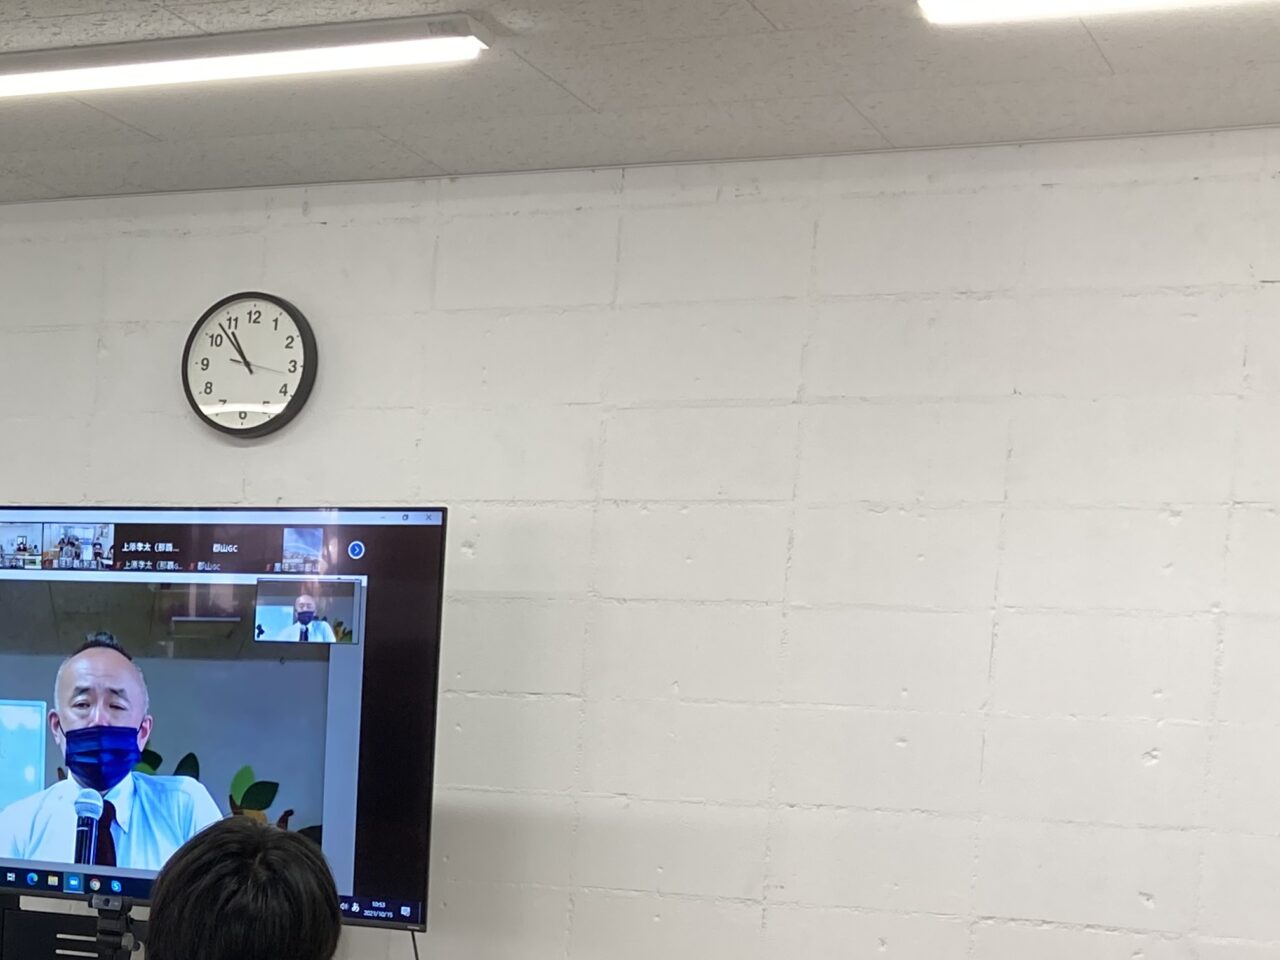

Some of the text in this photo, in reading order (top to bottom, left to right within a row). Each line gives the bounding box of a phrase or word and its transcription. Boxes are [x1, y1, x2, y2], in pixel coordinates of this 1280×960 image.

[226, 316, 239, 330] 11
[247, 310, 262, 324] 12
[272, 317, 279, 331] 1
[209, 333, 223, 347] 10
[285, 335, 295, 349] 2
[200, 357, 210, 371] 9
[288, 360, 298, 374] 3
[204, 381, 213, 395] 8
[279, 383, 289, 397] 4
[213, 543, 238, 553] 郡山GC
